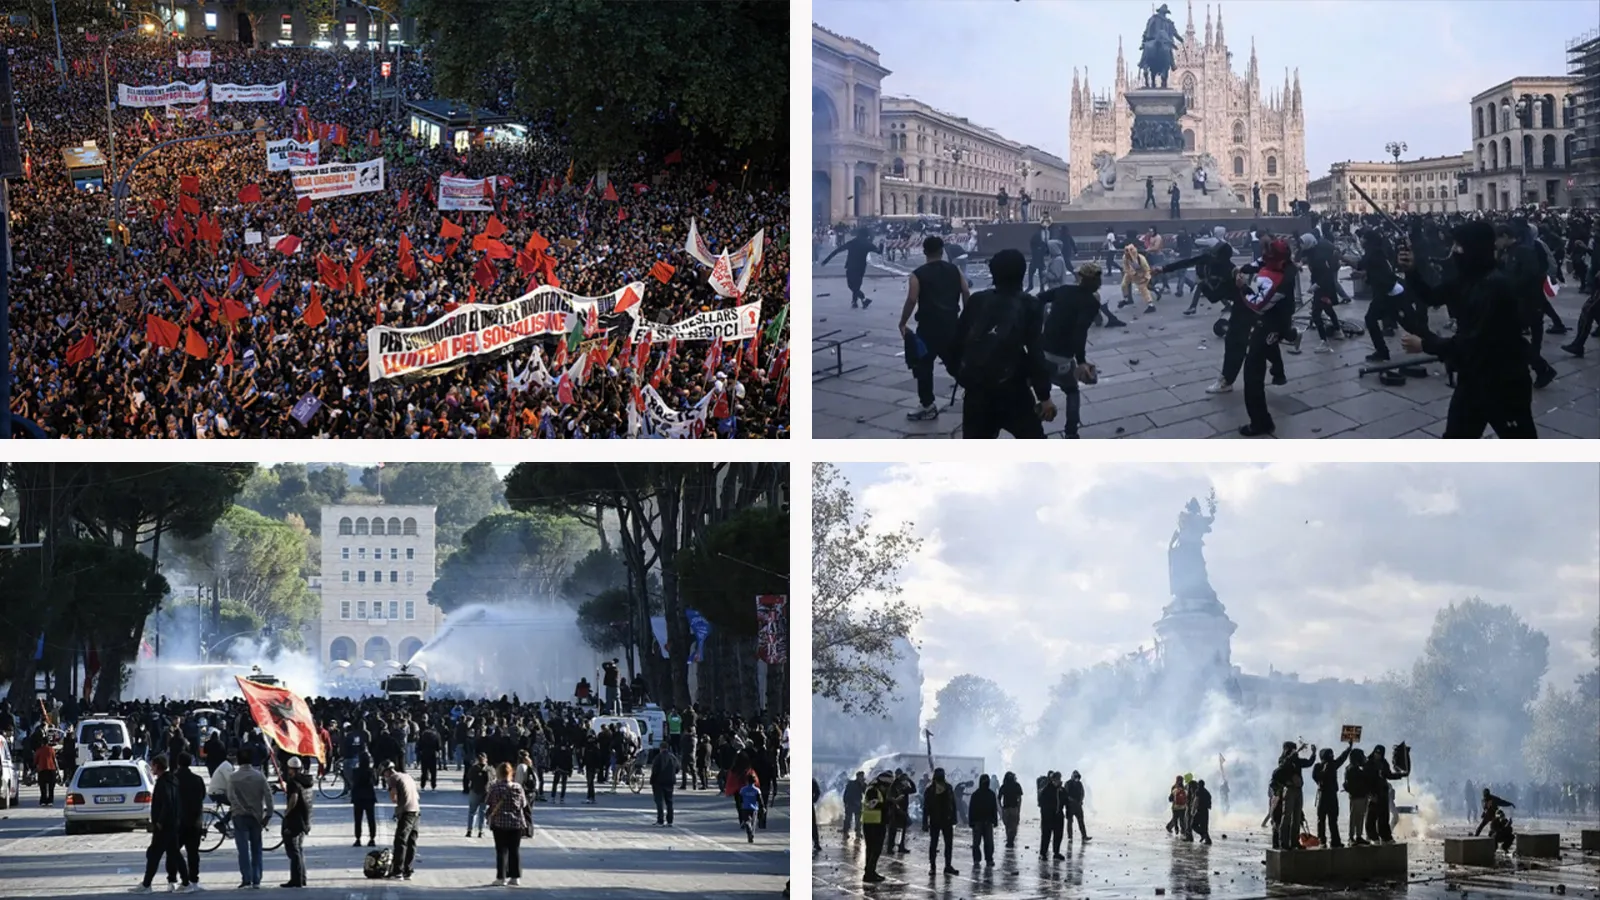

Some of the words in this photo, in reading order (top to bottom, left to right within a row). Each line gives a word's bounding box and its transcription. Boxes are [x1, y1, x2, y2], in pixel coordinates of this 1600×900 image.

[702, 309, 739, 324] LLARS
[379, 331, 402, 353] PER
[382, 340, 449, 375] LLUITEM
[452, 333, 479, 356] PEL
[482, 312, 567, 349] SOCIALISME
